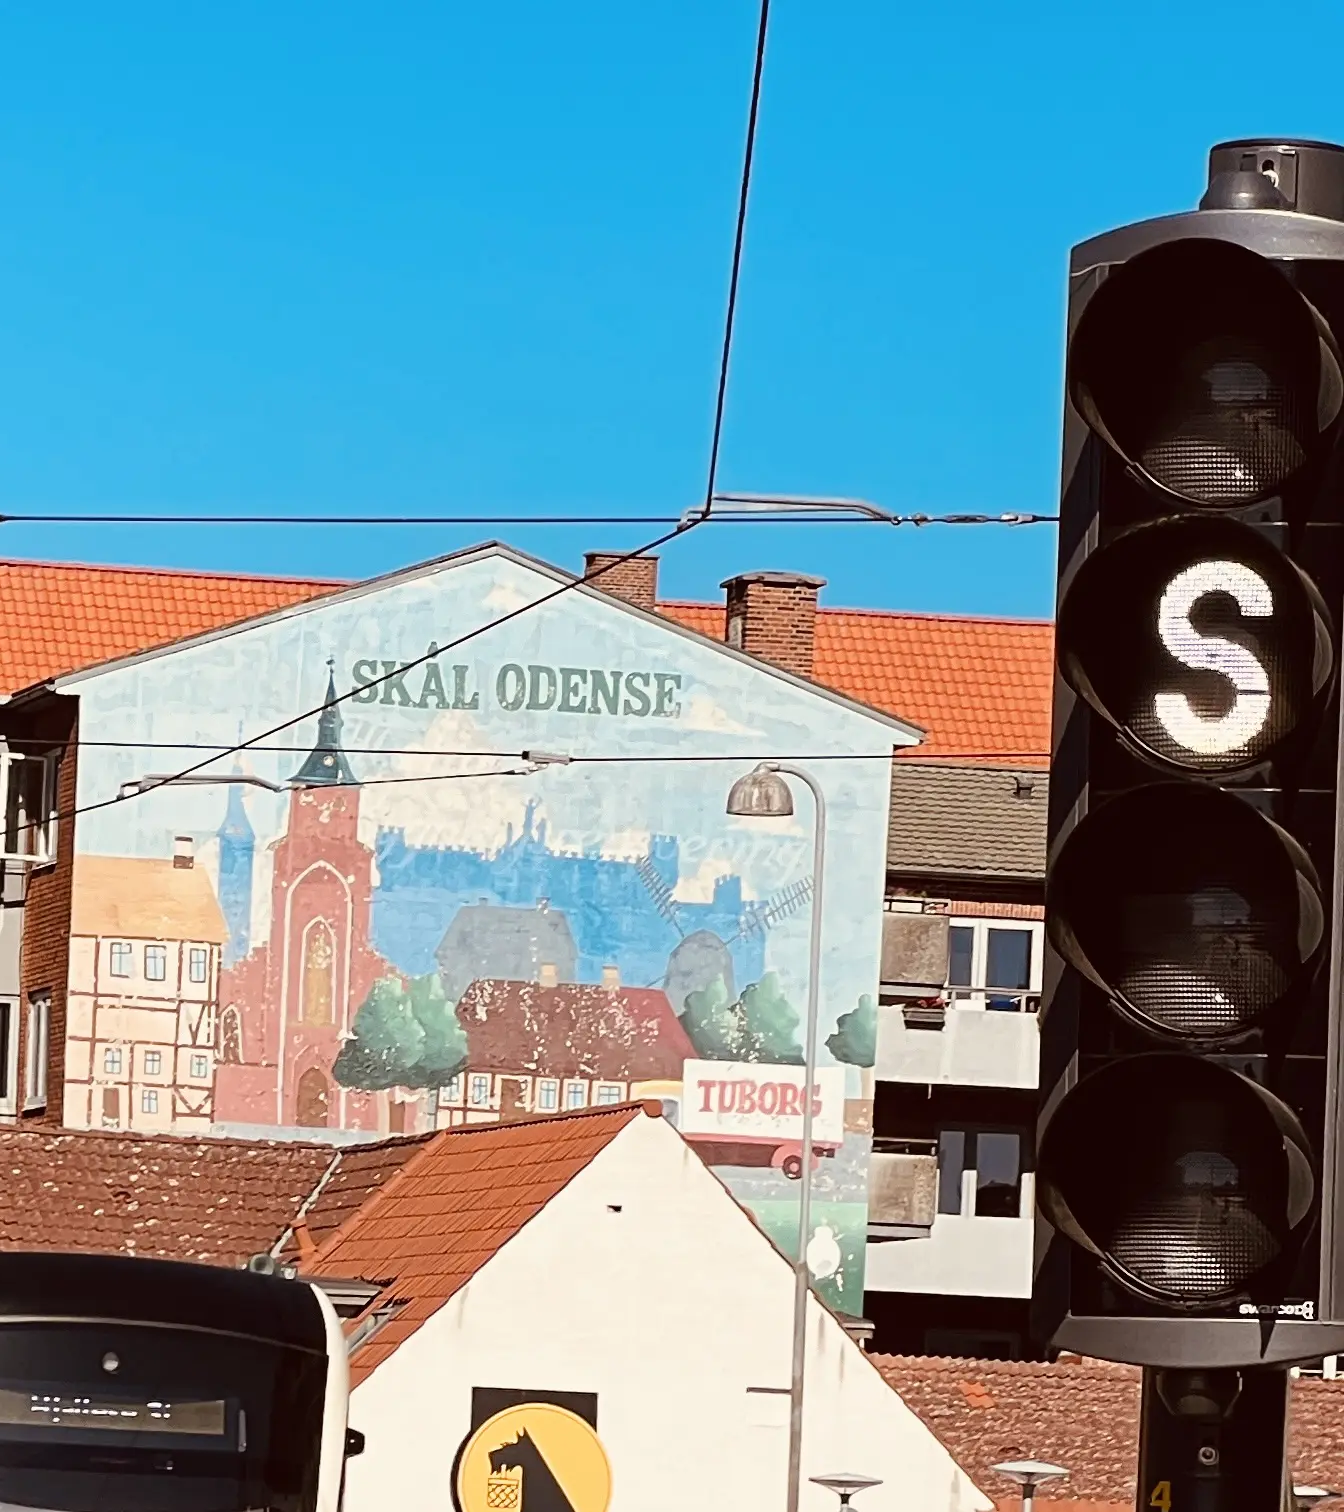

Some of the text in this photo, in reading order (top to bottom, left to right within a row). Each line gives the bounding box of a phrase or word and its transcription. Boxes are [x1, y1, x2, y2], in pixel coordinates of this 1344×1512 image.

[351, 641, 683, 719] SKÅL ODENSE
[1155, 559, 1274, 755] S
[697, 1079, 823, 1118] TUBORG
